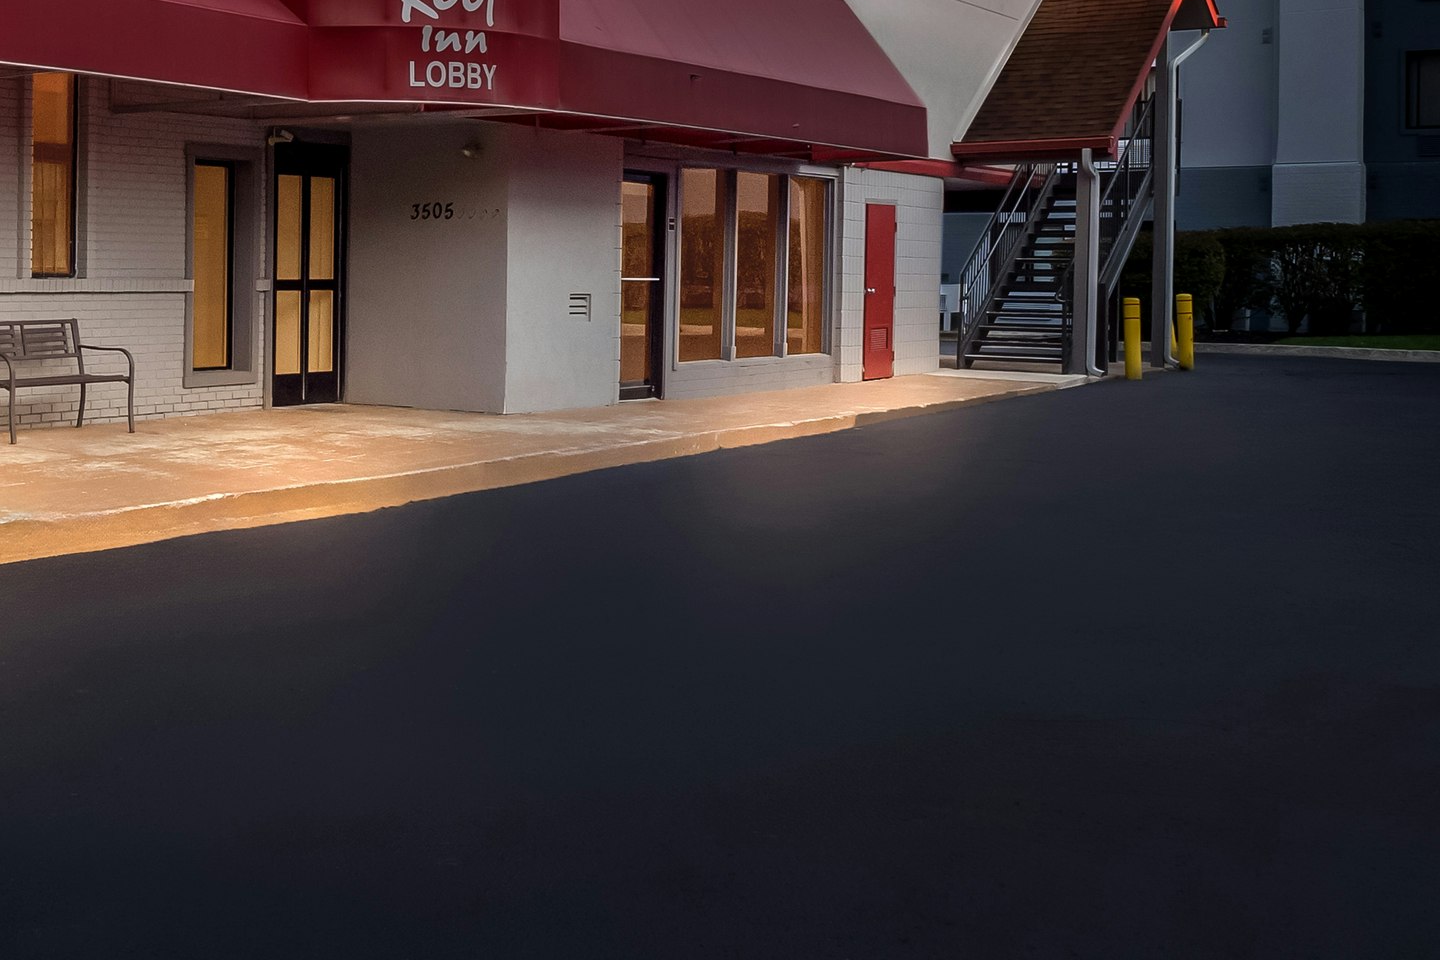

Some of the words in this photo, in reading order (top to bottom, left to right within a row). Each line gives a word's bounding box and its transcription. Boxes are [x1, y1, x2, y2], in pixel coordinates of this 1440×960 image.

[421, 25, 488, 54] Inn
[410, 60, 497, 90] LOBBY
[410, 202, 454, 220] 3505
